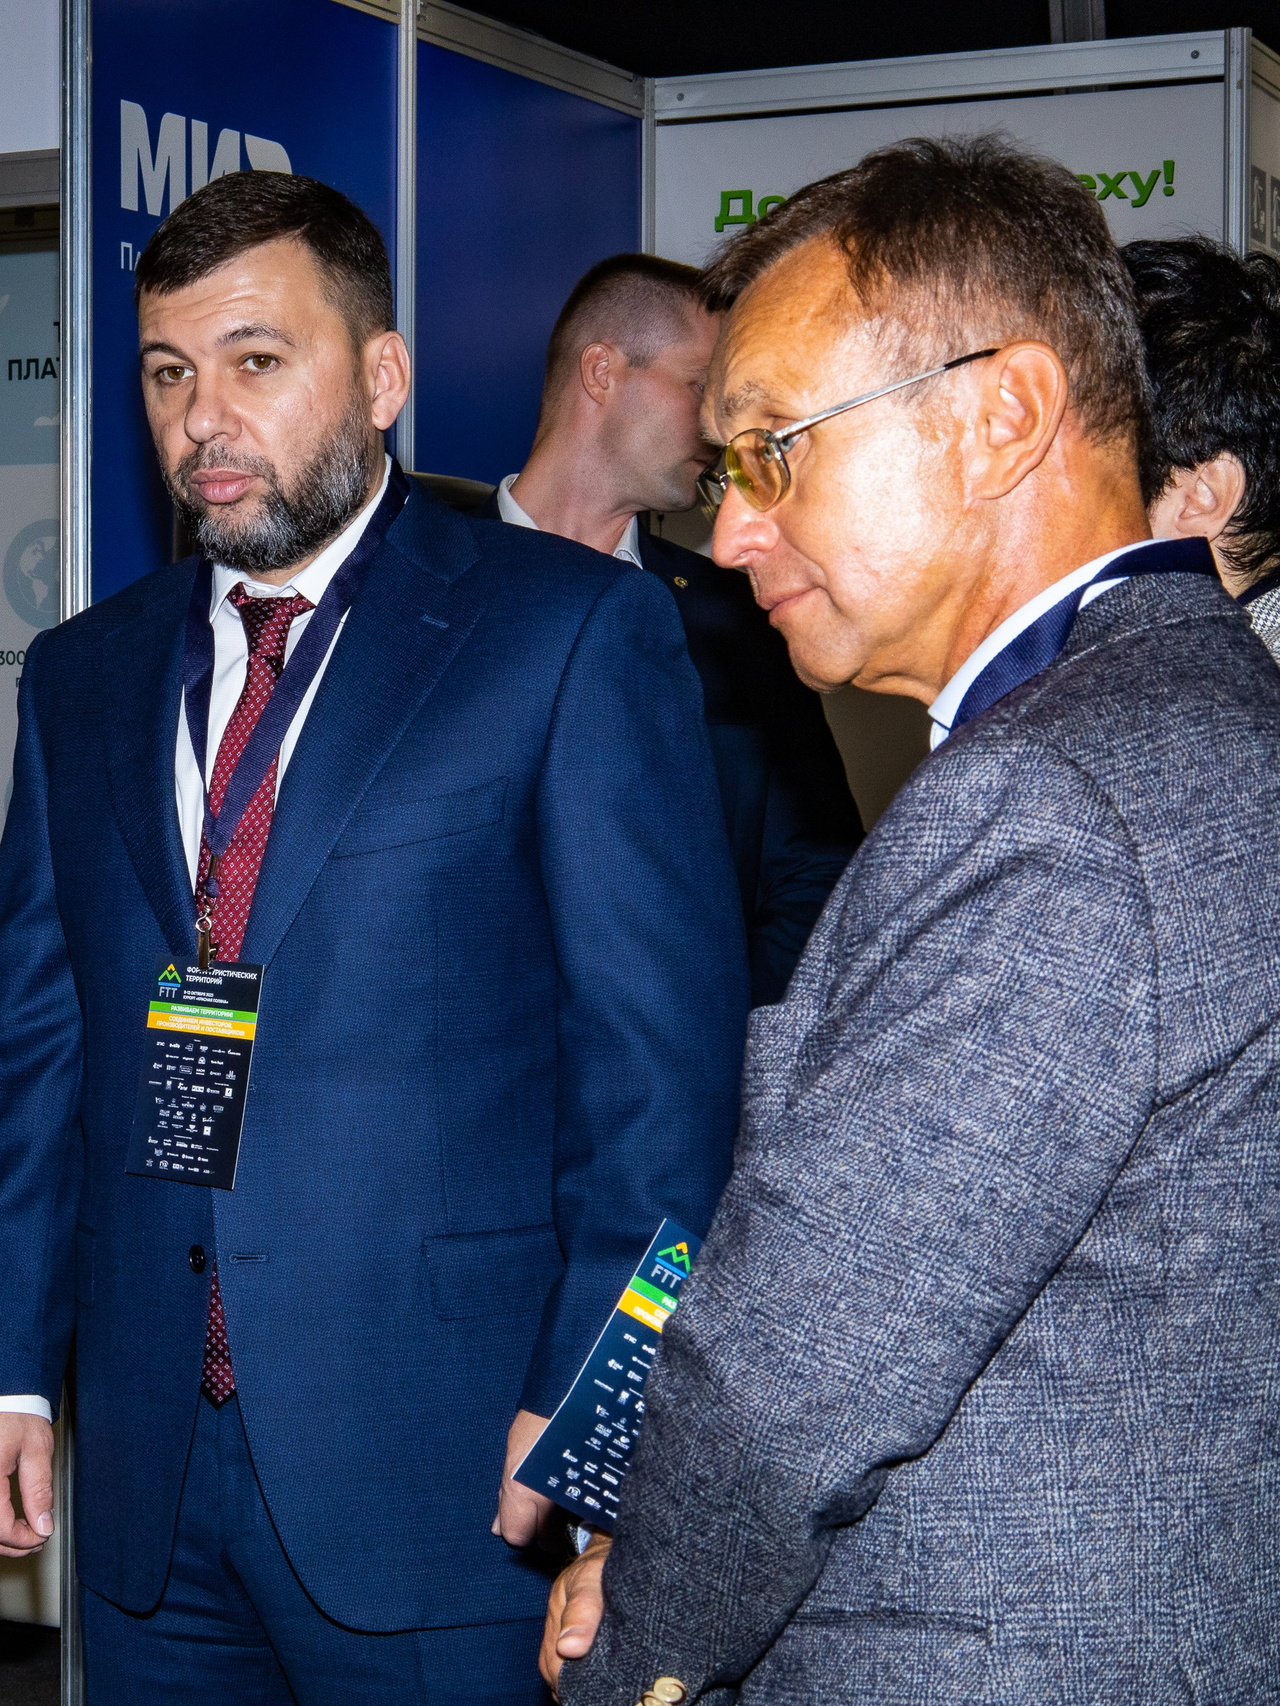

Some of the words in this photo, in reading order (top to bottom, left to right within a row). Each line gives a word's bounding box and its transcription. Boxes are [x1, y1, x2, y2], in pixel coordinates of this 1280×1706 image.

[185, 974, 223, 985] ТЕРРИТОРИЙ
[209, 967, 258, 980] УРИСТИЧЕСКИХ
[158, 986, 178, 999] FTT
[170, 1005, 200, 1015] РАЗВИВАЕМ
[156, 1020, 200, 1032] ПРОИЗВОДИТЕЛЕЙ
[168, 1015, 199, 1025] СОЕДИНЯЕМ
[650, 1263, 682, 1289] FTT
